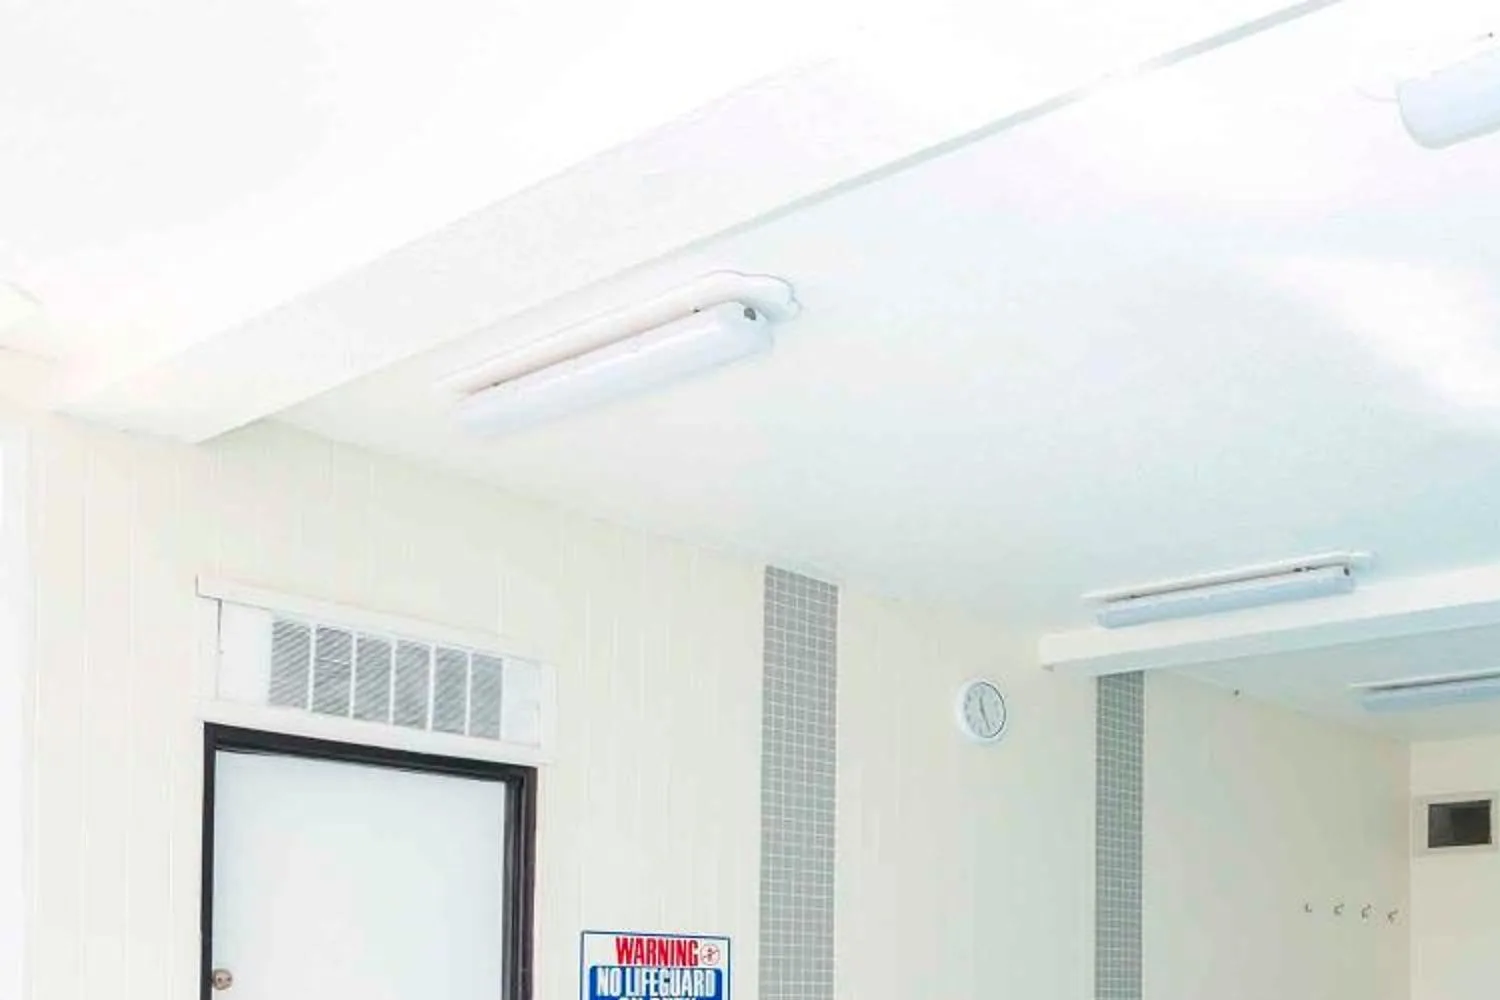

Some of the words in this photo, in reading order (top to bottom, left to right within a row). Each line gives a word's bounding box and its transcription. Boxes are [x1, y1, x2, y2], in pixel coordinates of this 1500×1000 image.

[615, 937, 699, 966] WARNING
[597, 968, 622, 997] NO
[625, 968, 716, 998] LIFEGUARD
